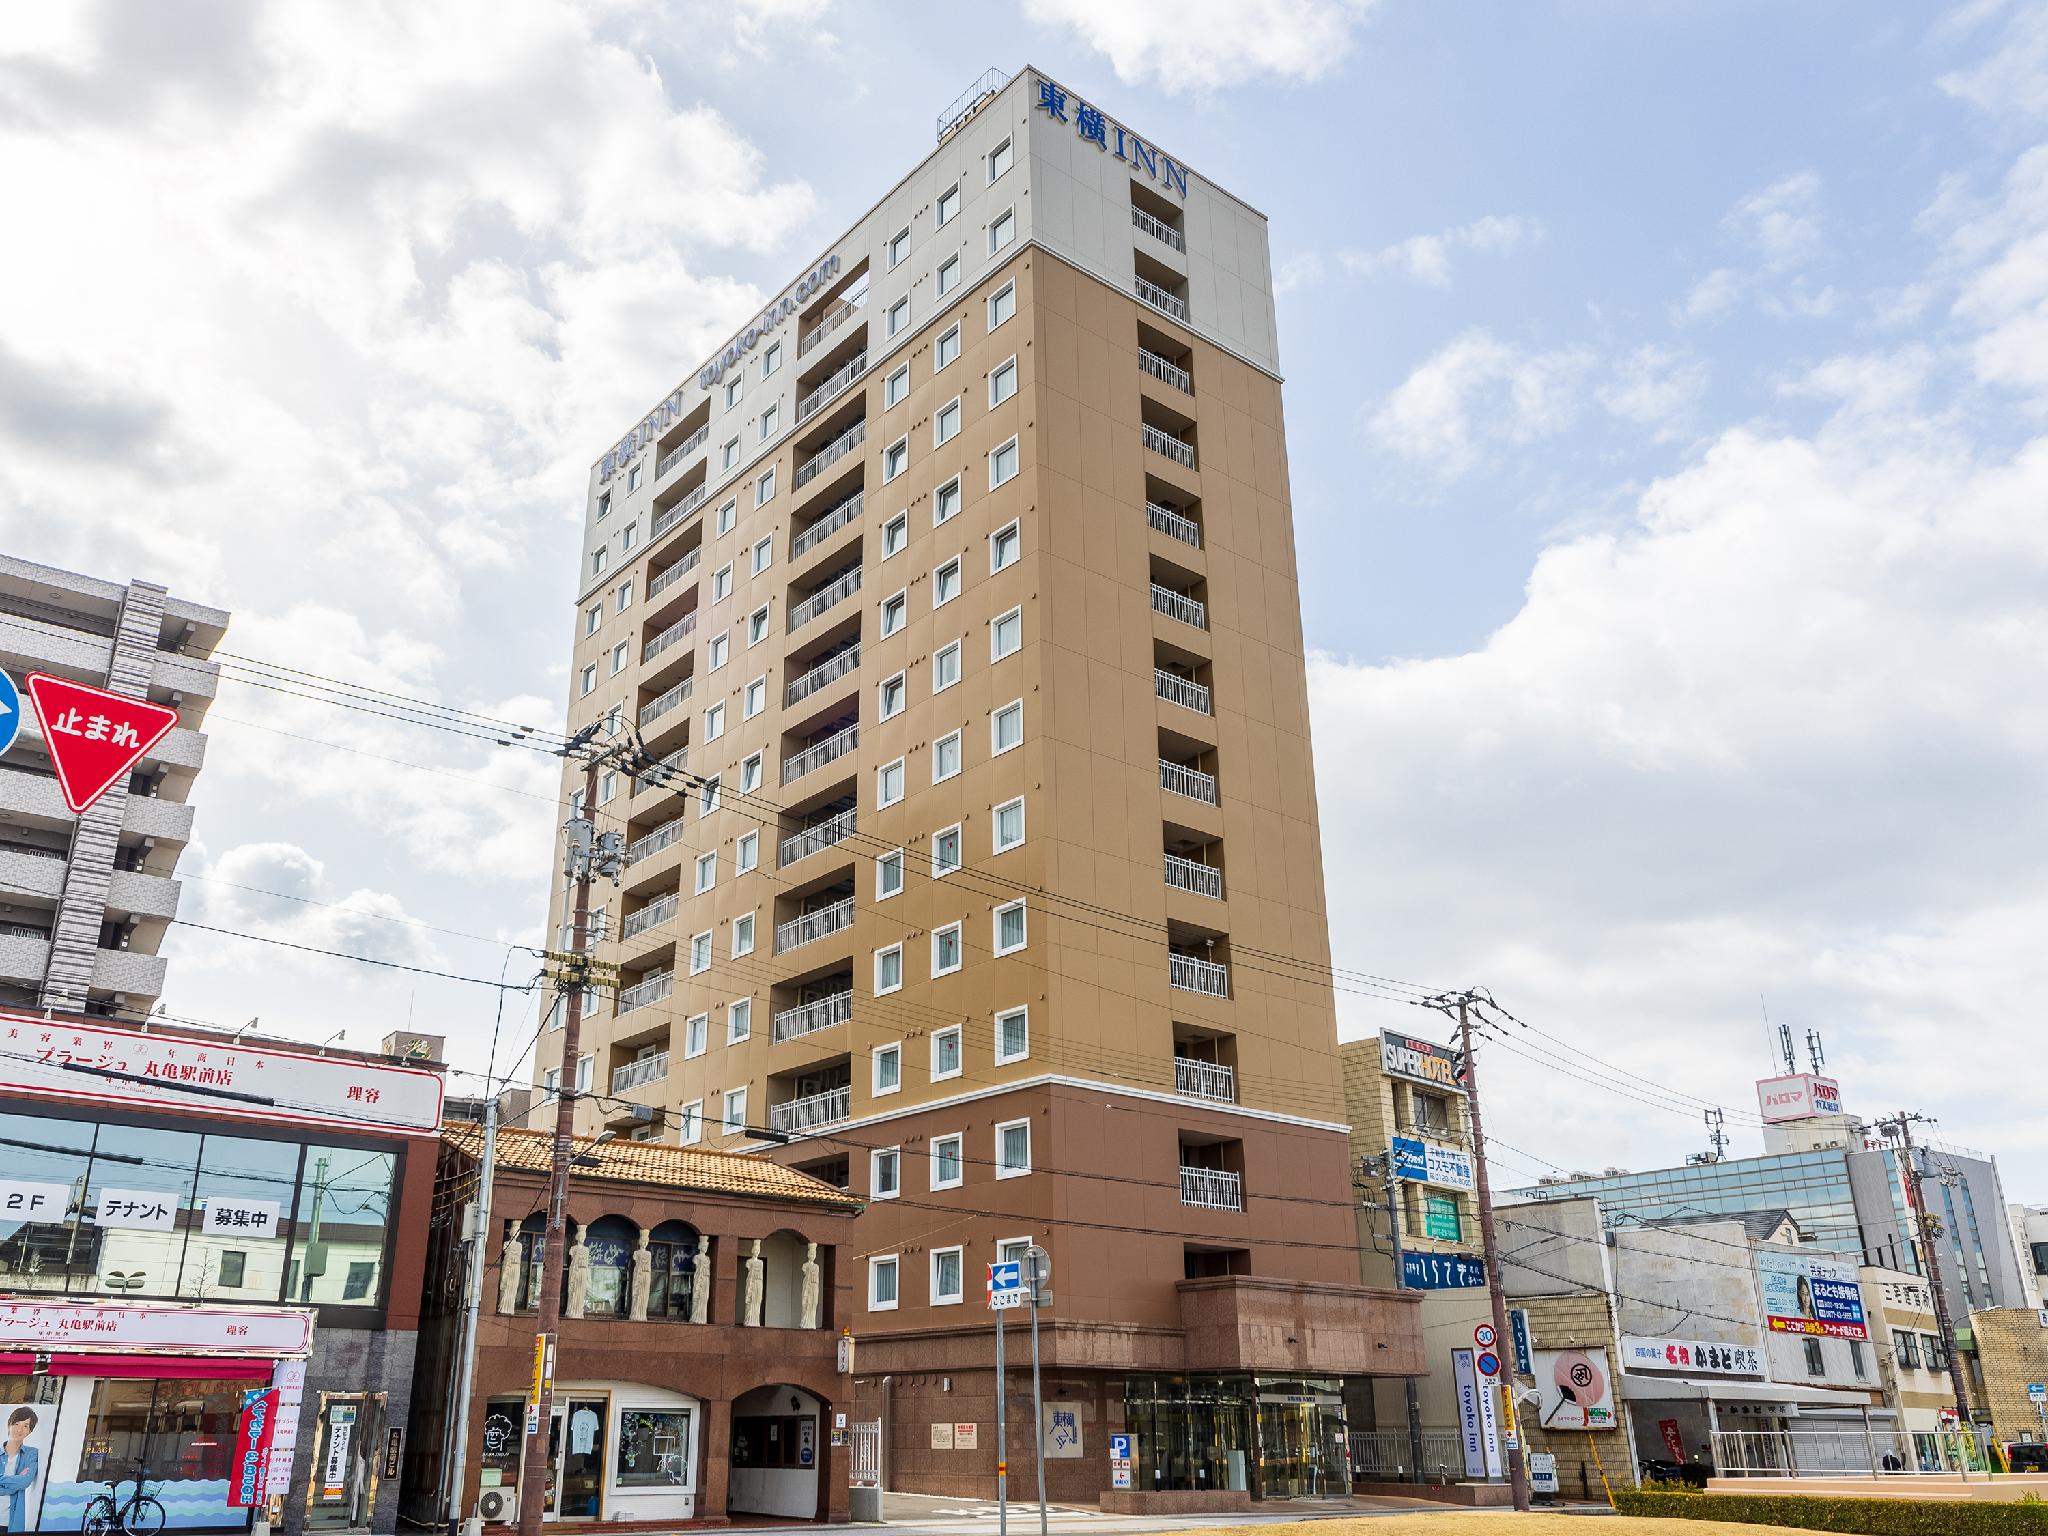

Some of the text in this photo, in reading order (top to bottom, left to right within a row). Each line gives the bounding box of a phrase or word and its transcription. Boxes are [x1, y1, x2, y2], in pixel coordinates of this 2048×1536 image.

[699, 254, 840, 390] toyoko-inn.com
[51, 707, 141, 749] 止まれ
[36, 1046, 129, 1072] プラージュ
[143, 1060, 233, 1086] 丸亀駅前店
[346, 1085, 380, 1104] 理容
[1428, 1158, 1470, 1179] コスモ不動産
[105, 1200, 169, 1220] テナント
[214, 1207, 269, 1228] 募集中
[993, 1293, 1019, 1306] ここまで
[0, 1315, 118, 1332] ラージュ 丸亀駅前店
[1479, 1330, 1492, 1342] 30
[1665, 1344, 1690, 1366] 名物
[1695, 1345, 1733, 1370] かまど
[1734, 1349, 1758, 1371] 喫茶
[1482, 1385, 1493, 1428] toyoko
[1463, 1384, 1478, 1453] toyoko inn
[85, 1446, 114, 1454] PLAGE
[1114, 1437, 1127, 1450] P
[1487, 1433, 1495, 1453] inn
